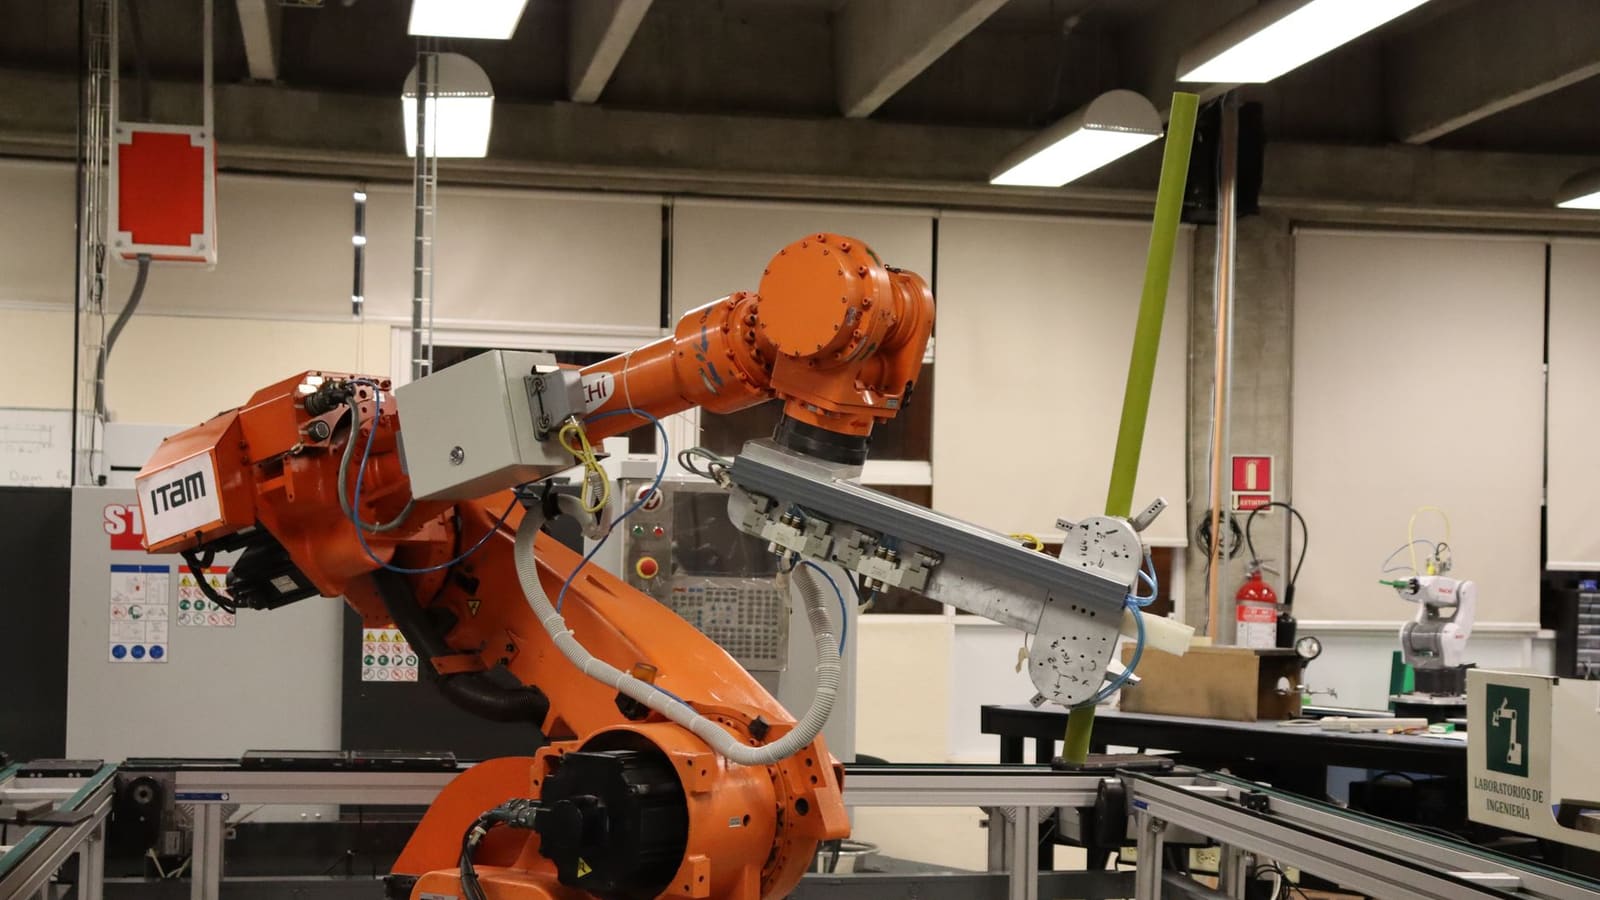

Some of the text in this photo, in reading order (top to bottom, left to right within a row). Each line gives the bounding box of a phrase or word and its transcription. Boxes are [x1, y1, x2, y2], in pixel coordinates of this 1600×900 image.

[1474, 777, 1544, 803] LABORATORIOS DE
[1486, 800, 1530, 820] INGENIERÍA
